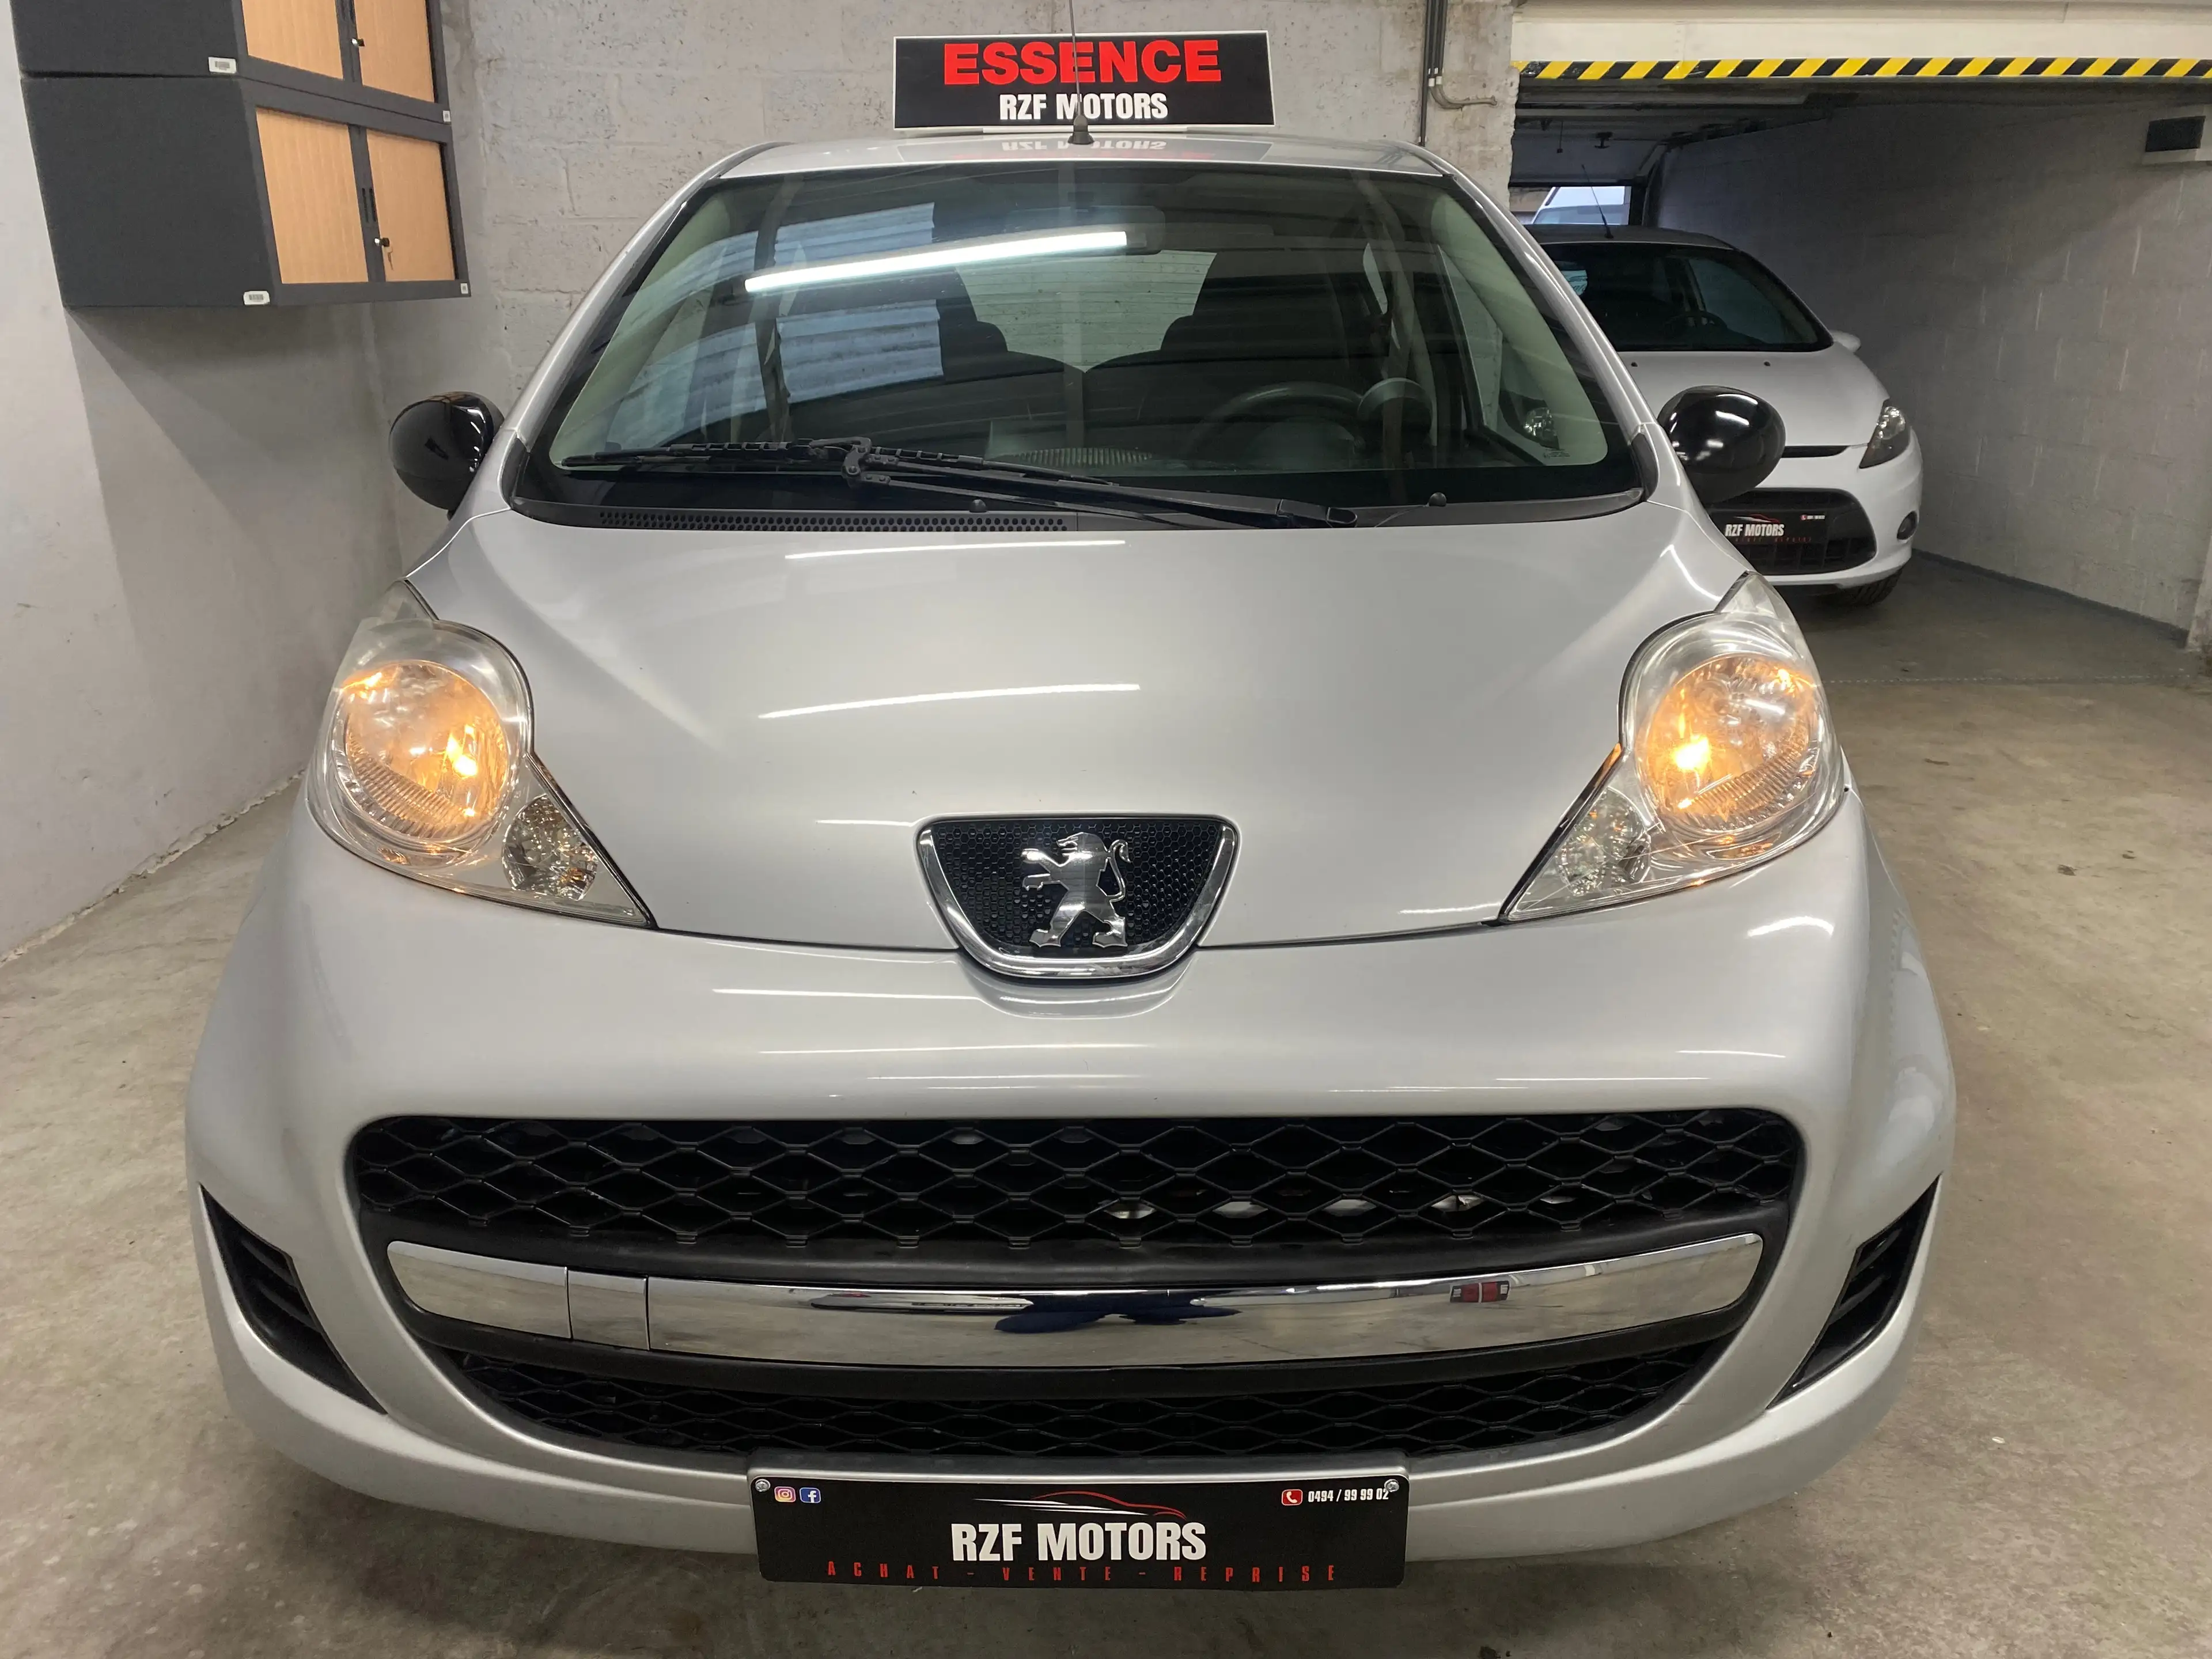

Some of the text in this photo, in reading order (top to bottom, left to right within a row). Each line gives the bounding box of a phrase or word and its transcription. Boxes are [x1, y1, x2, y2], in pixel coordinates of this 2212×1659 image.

[944, 40, 1222, 85] ESSENCE
[999, 92, 1169, 120] RZF MOTORS
[1725, 523, 1785, 537] RZF MOTORS
[1308, 1490, 1334, 1503] 0494
[1344, 1489, 1357, 1501] 99
[1359, 1488, 1373, 1501] 99
[1376, 1488, 1389, 1500] 02
[950, 1522, 1206, 1561] RZF MOTORS
[827, 1560, 939, 1580] ACHAT
[1002, 1566, 1111, 1581] VENTE
[1173, 1564, 1335, 1582] REPRISE
